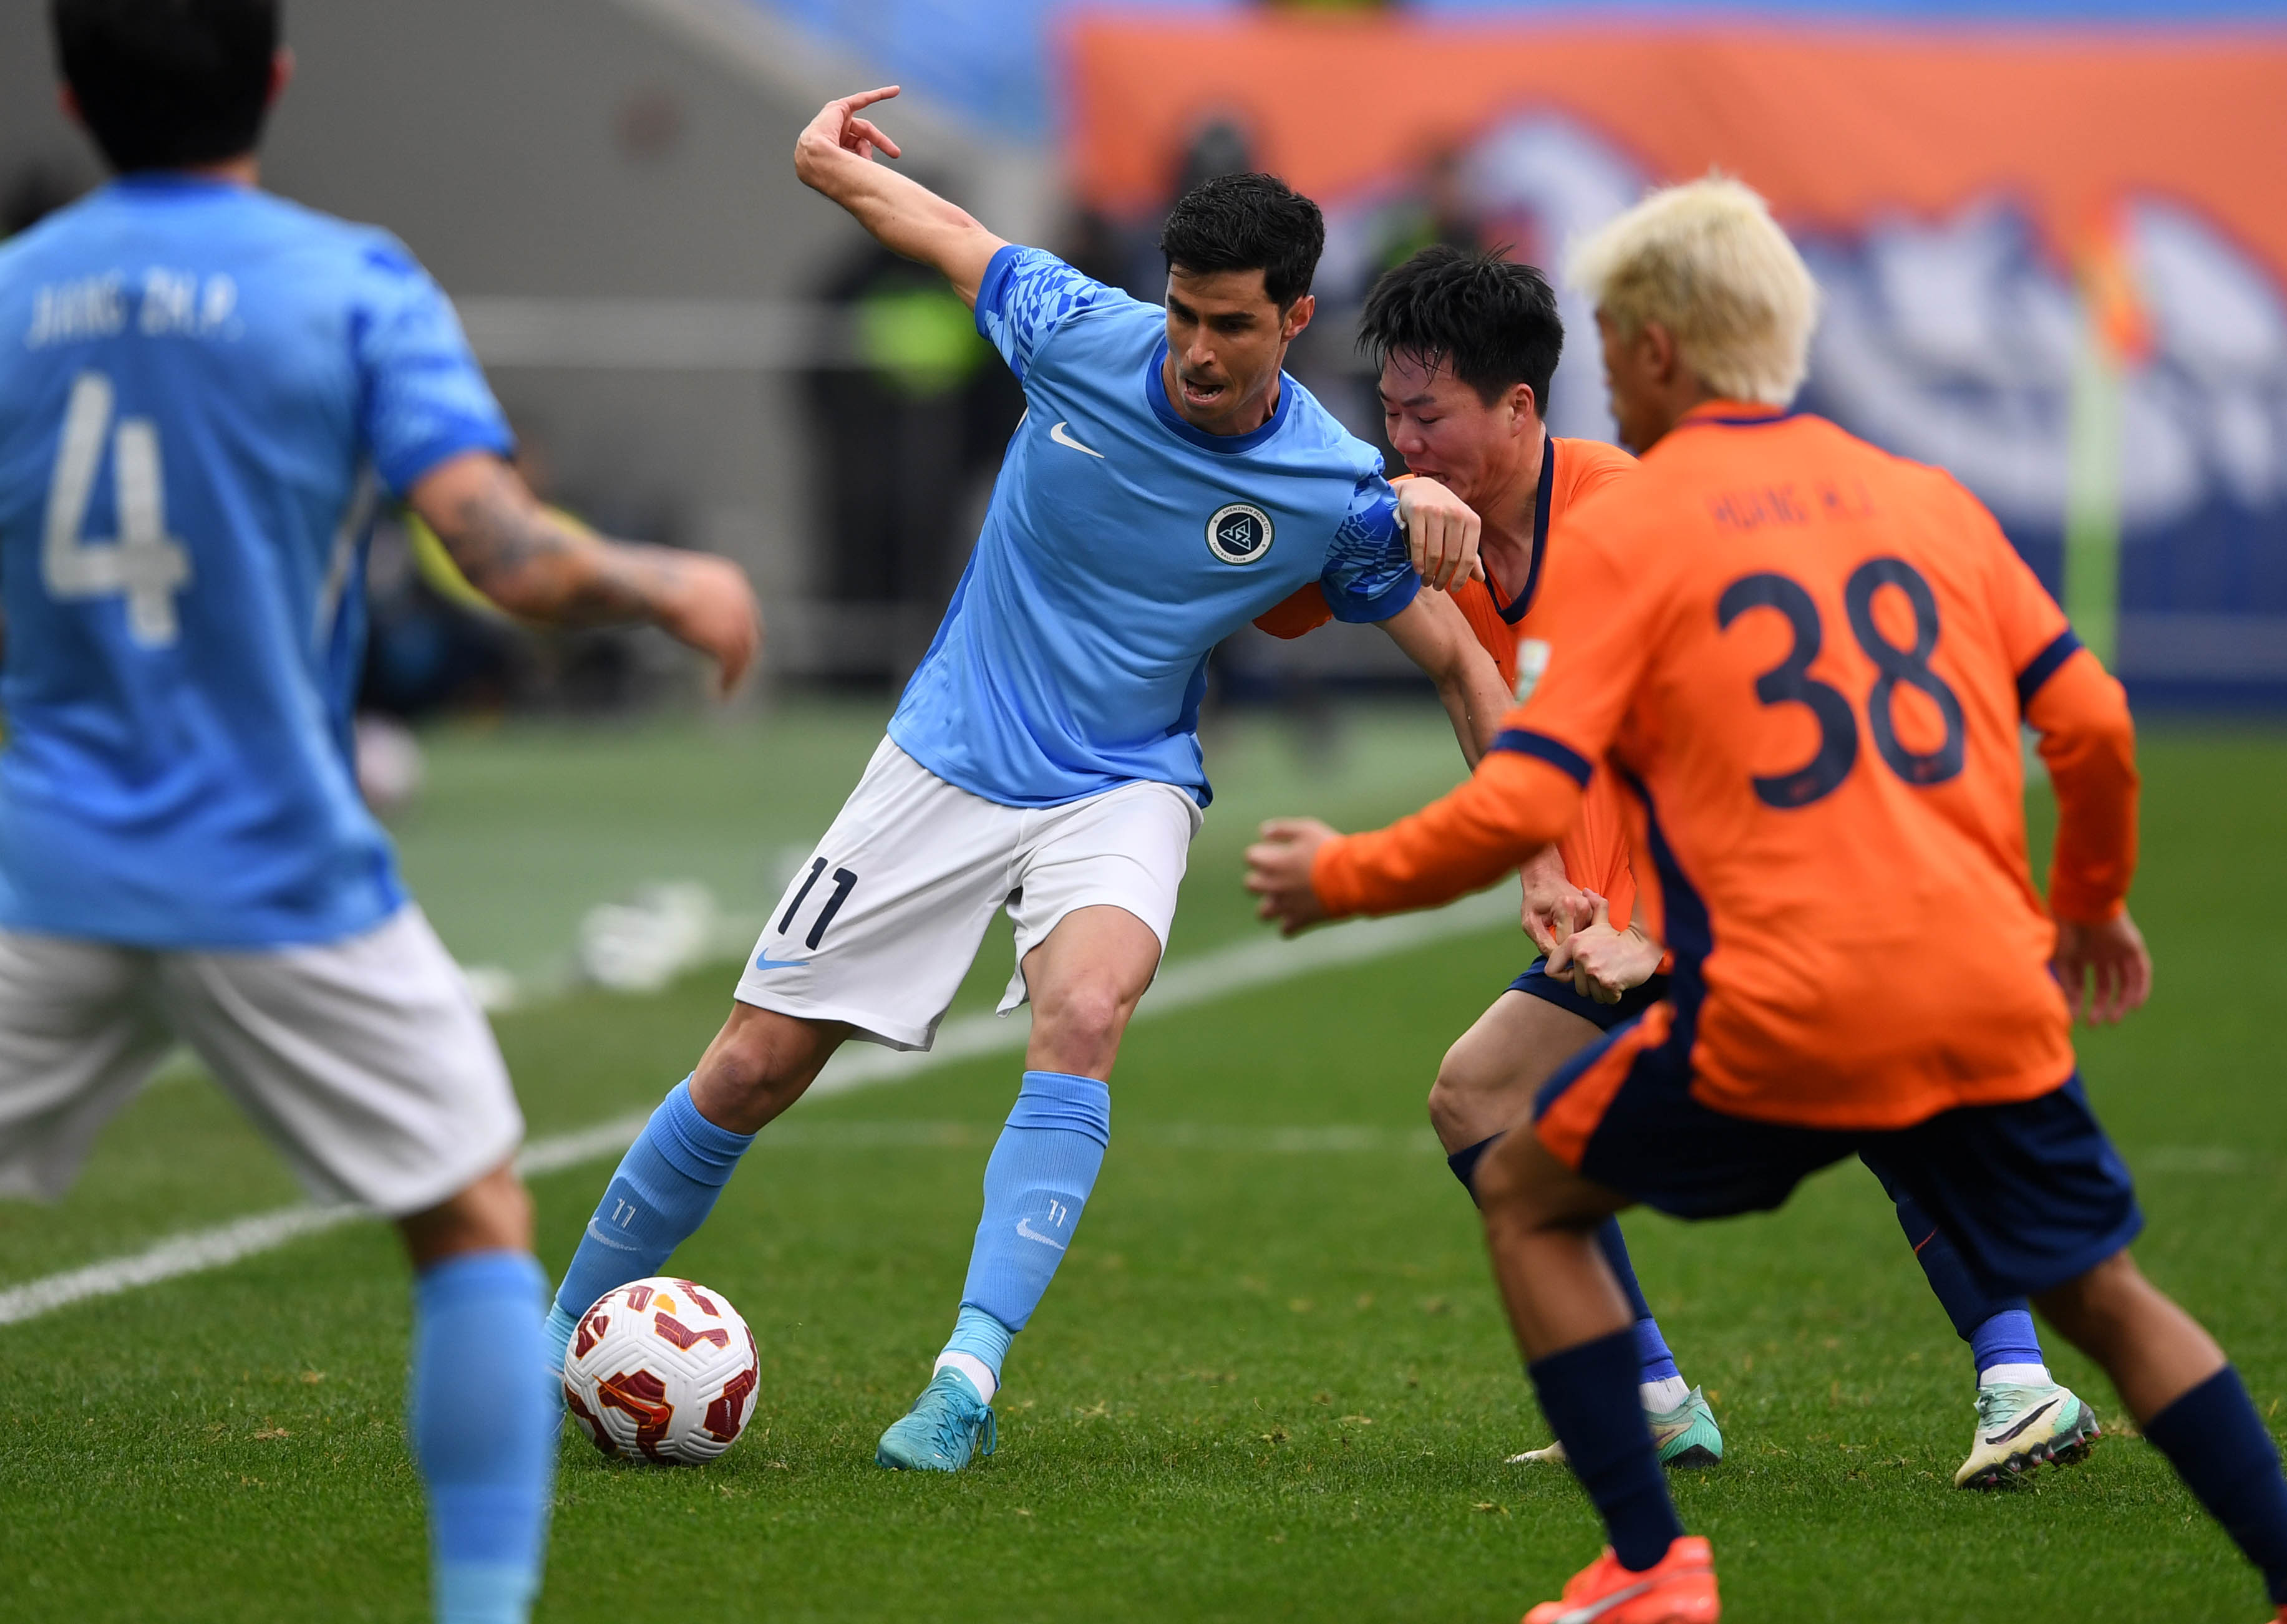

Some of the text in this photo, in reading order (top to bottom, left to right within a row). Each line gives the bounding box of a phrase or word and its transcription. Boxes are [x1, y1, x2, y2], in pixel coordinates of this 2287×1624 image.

[42, 370, 191, 650] 4
[1223, 506, 1253, 515] SHENZHEN
[1253, 511, 1266, 523] PENG
[1212, 542, 1231, 560] FOOTBALL
[1717, 556, 1966, 810] 38
[778, 856, 858, 951] 11
[611, 1197, 636, 1228] 11
[1047, 1199, 1067, 1228] 11
